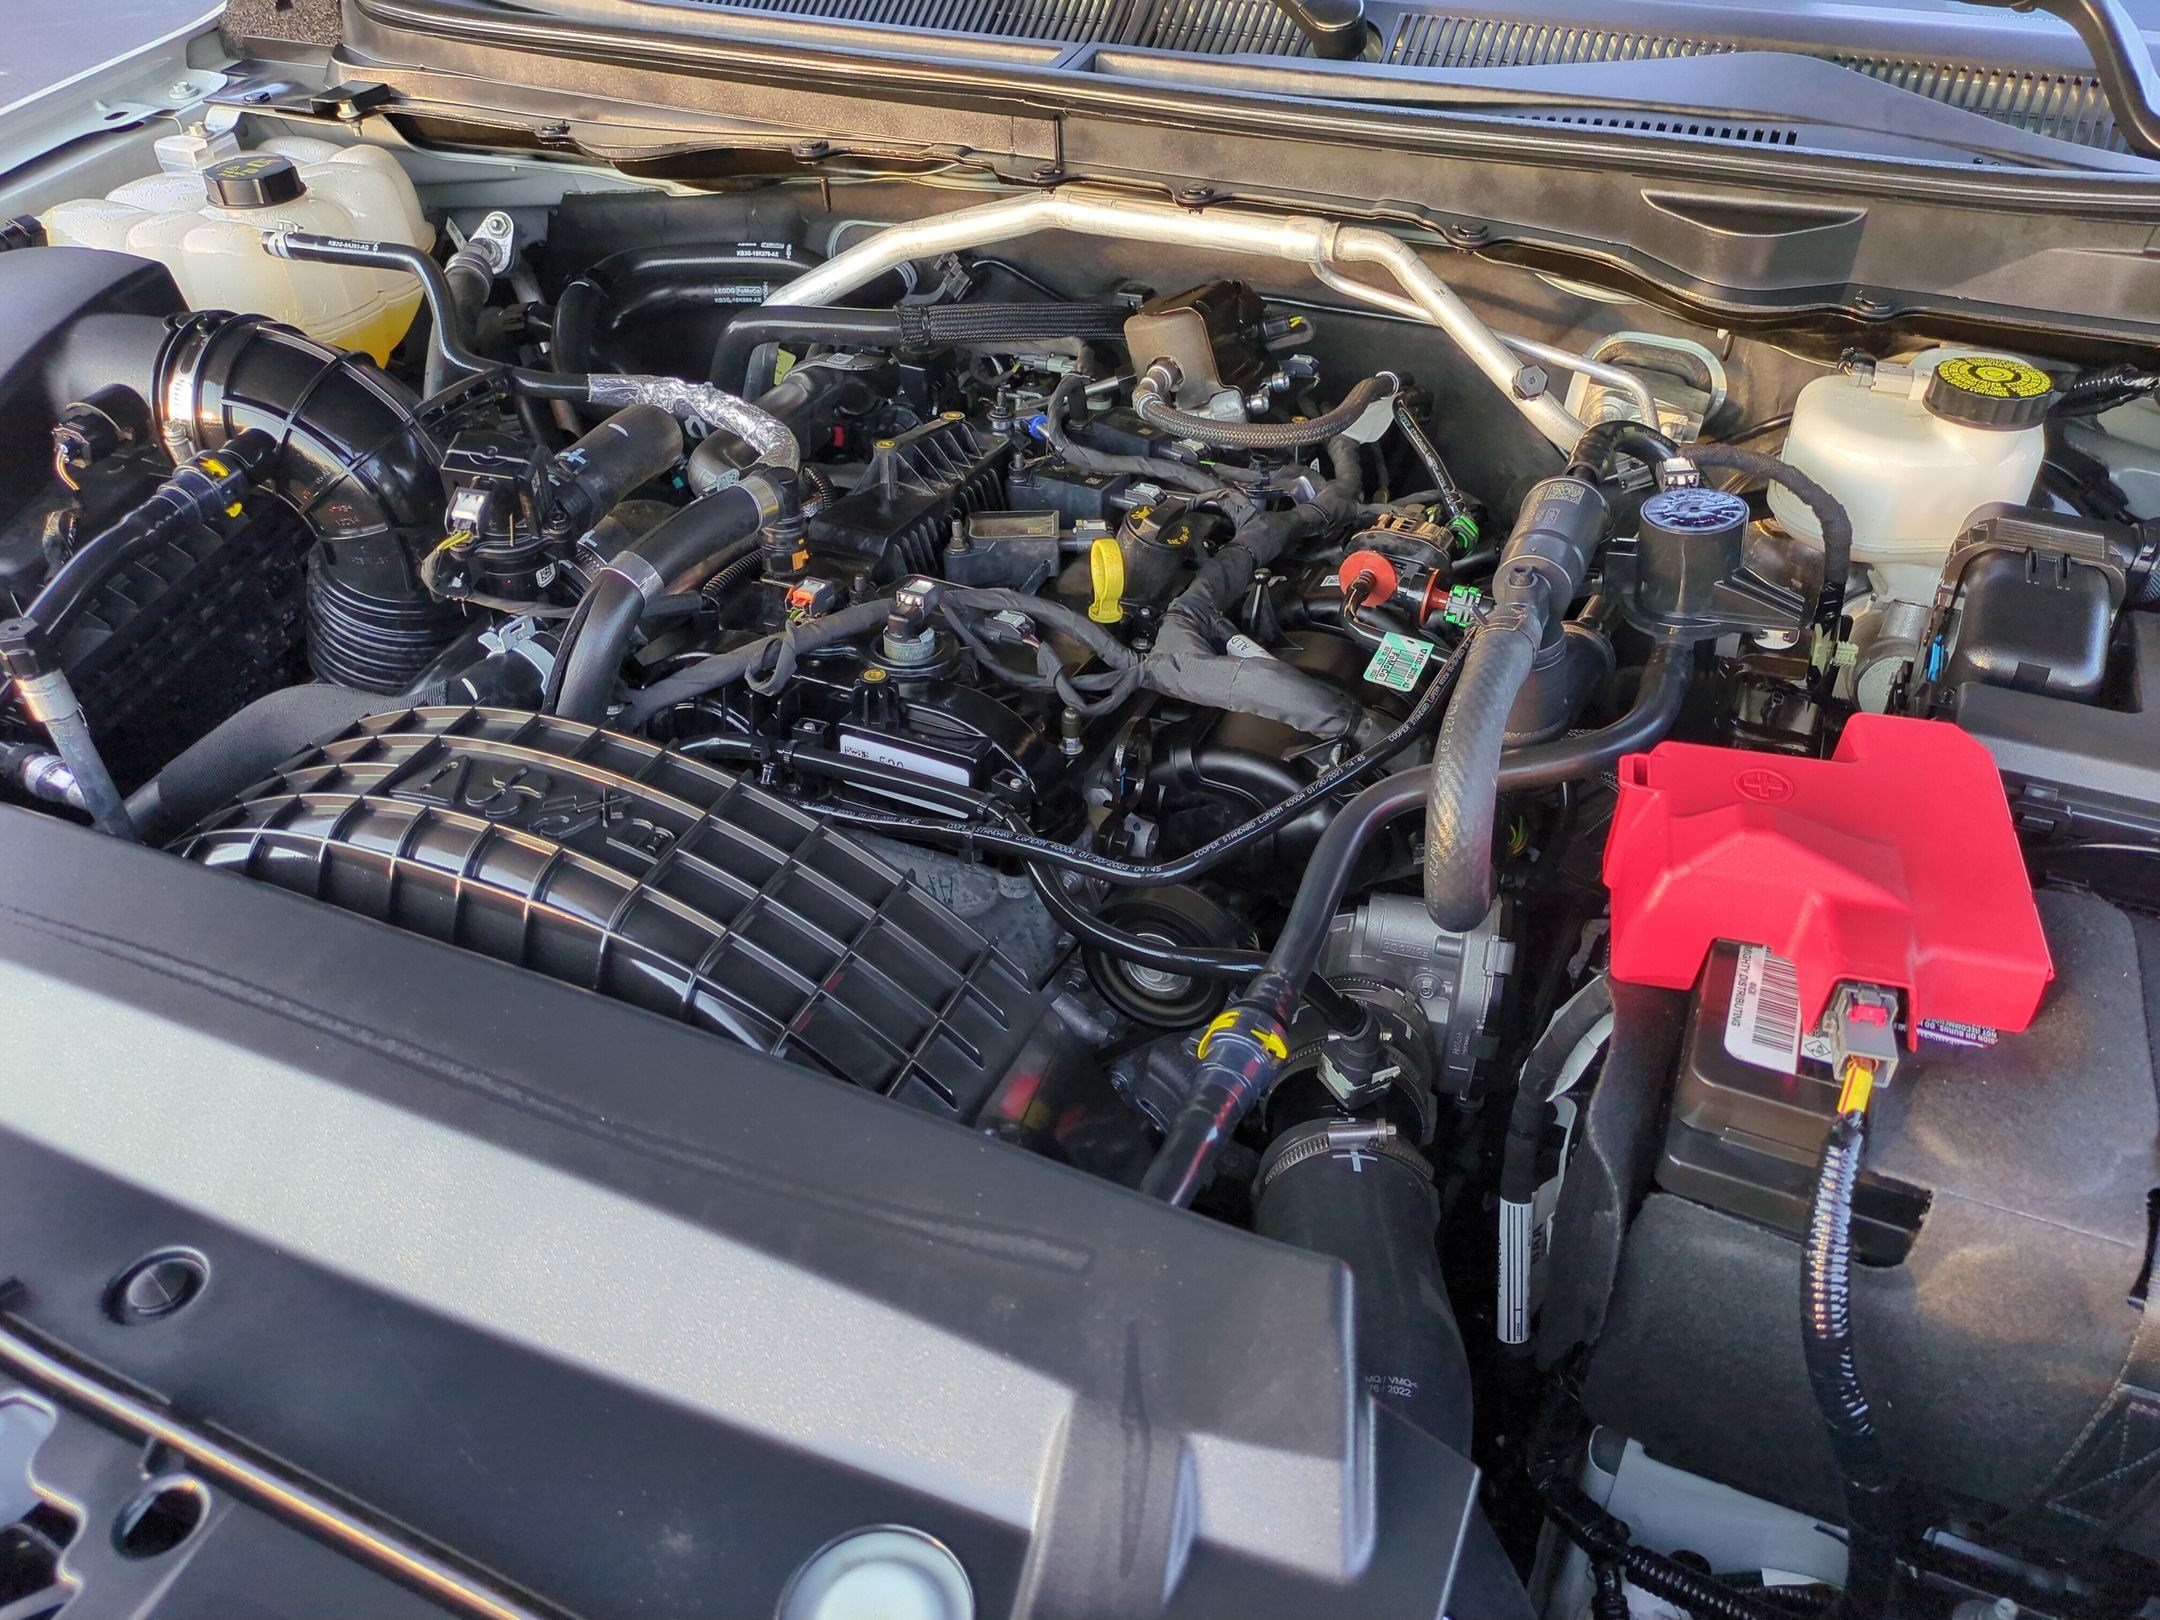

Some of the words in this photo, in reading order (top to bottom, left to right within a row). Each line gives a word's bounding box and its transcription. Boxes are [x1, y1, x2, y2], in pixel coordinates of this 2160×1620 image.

[1379, 651, 1400, 678] FoMoCo
[1388, 724, 1411, 742] COOPER
[1193, 840, 1220, 858] COOPER
[1222, 821, 1256, 843] STANDARD
[1258, 806, 1284, 824] LoPERM
[1285, 792, 1306, 808] 4000A
[1306, 768, 1344, 795] 01/30/2023
[1345, 753, 1367, 769] 04:45
[974, 825, 1014, 839] STANDARD
[1049, 840, 1076, 855] 4000A
[1078, 850, 1130, 871] 01/30/2023
[1133, 864, 1163, 873] 04:45
[1731, 973, 1748, 1027] DISTRIBUTING
[1387, 1385, 1412, 1398] 2022
